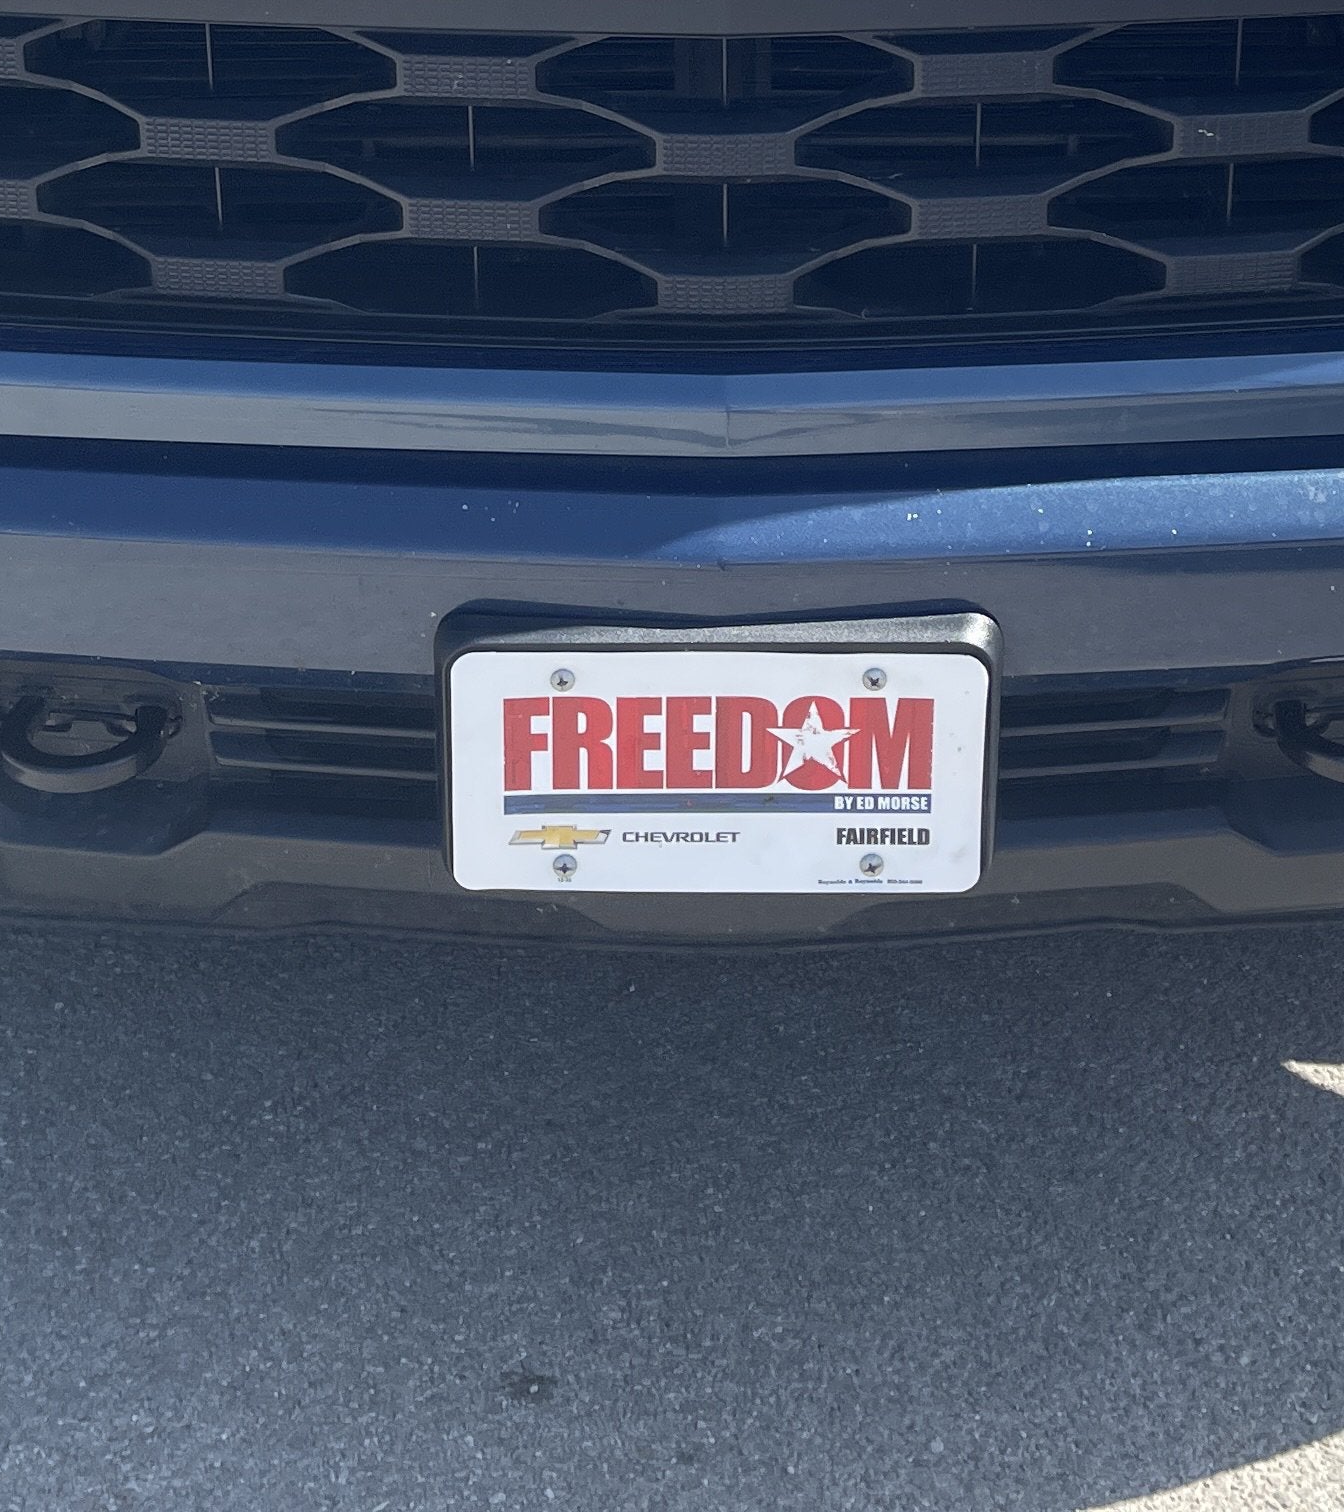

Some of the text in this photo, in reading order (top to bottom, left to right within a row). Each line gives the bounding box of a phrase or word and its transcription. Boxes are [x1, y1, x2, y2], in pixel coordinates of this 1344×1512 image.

[503, 695, 934, 791] FREEDOM
[834, 796, 928, 810] BY ED MORSE
[622, 831, 741, 843] CHEVROLET
[836, 827, 930, 845] FAIRFIELD
